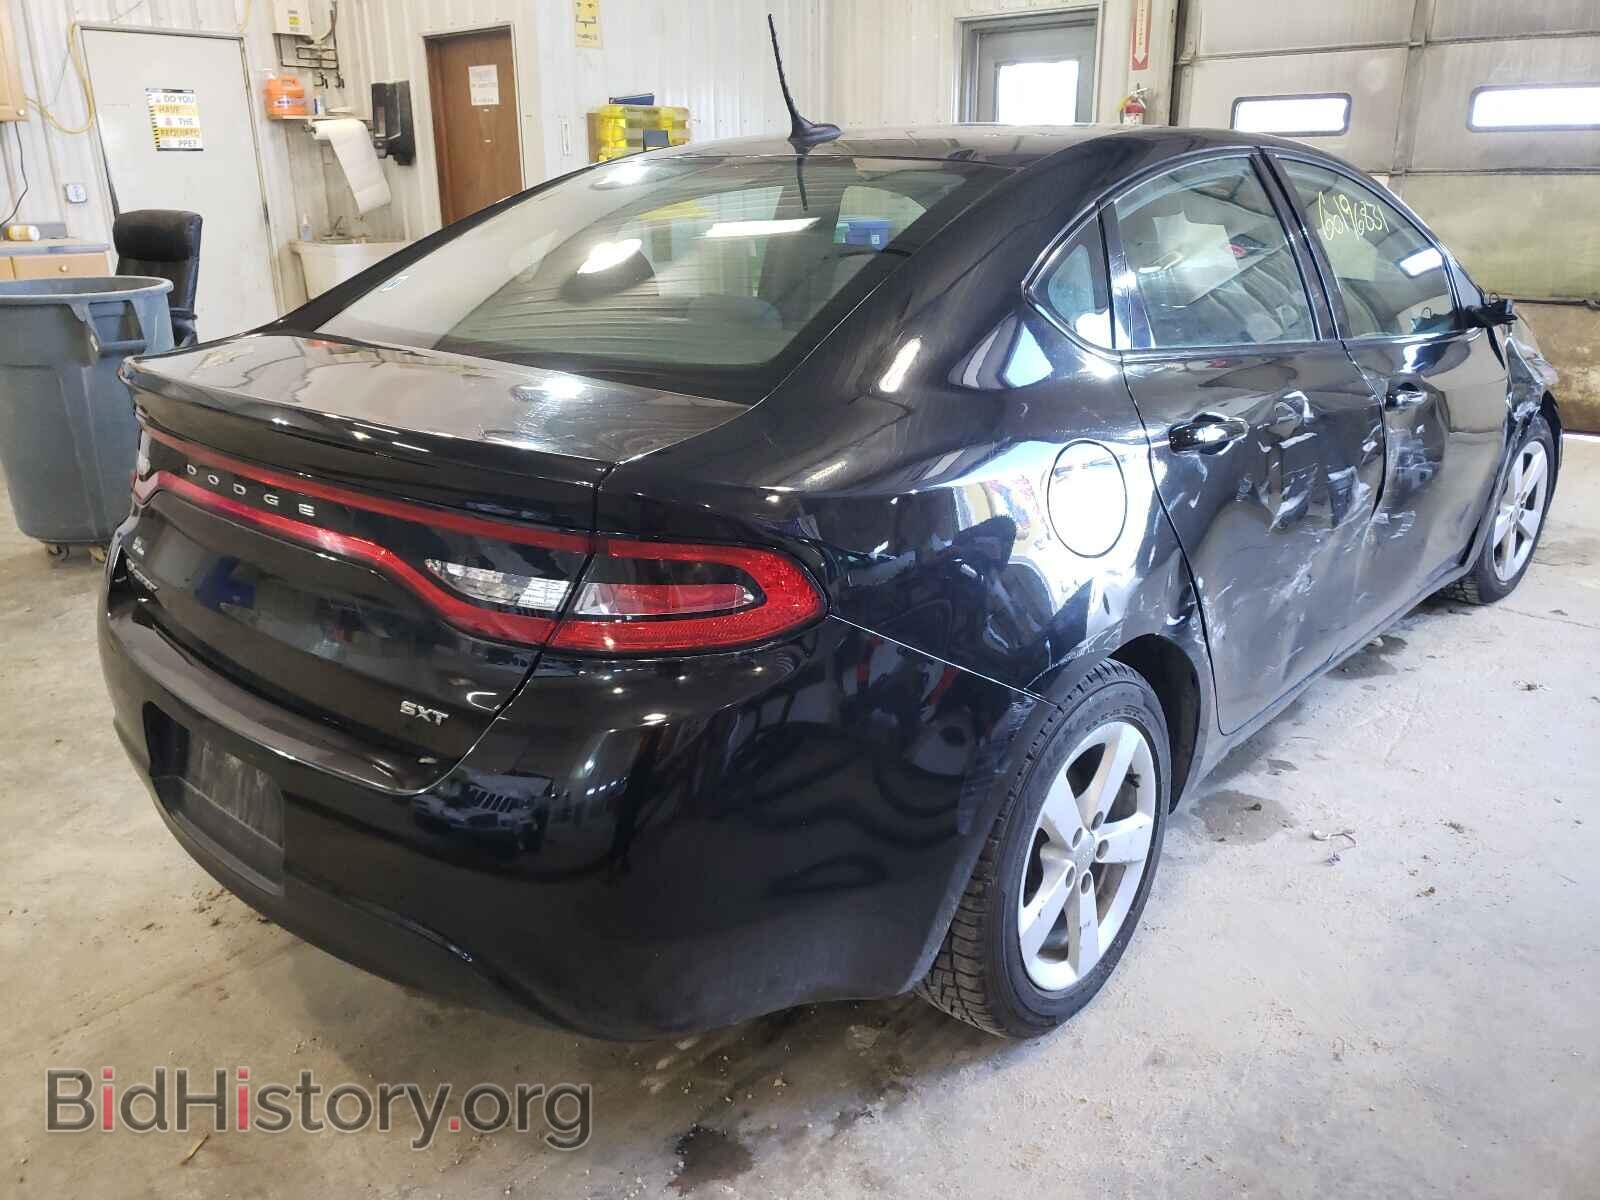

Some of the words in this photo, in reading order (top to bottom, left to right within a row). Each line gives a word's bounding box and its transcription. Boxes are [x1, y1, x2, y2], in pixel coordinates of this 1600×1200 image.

[163, 95, 177, 103] DO
[177, 95, 194, 104] YOU
[186, 464, 315, 517] DODGE
[399, 700, 449, 727] SXT
